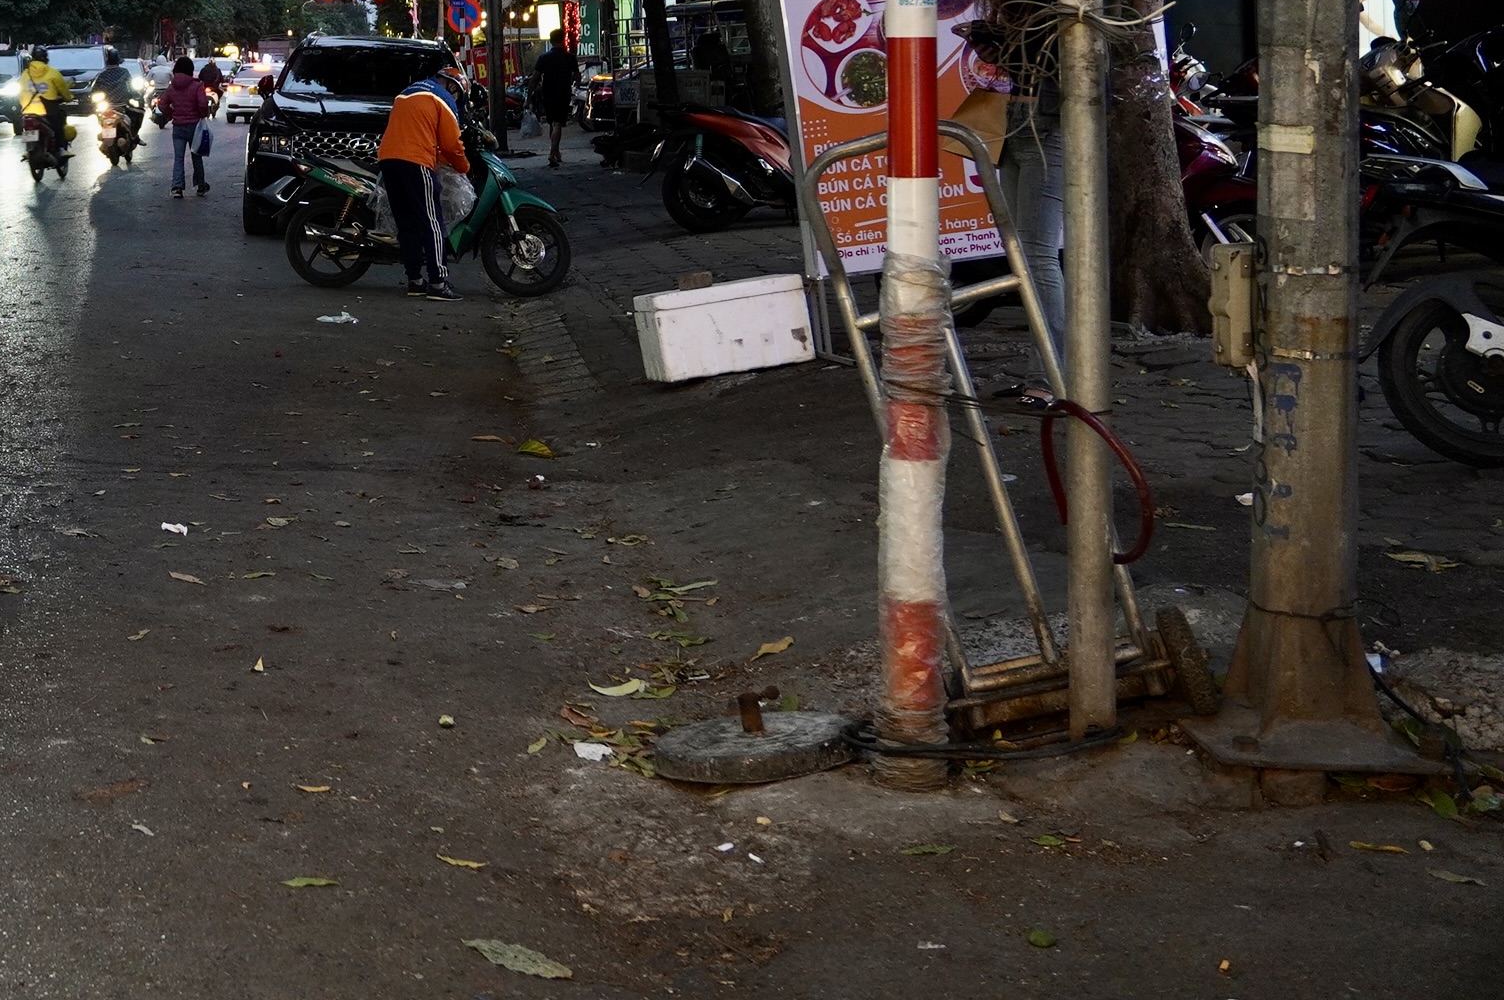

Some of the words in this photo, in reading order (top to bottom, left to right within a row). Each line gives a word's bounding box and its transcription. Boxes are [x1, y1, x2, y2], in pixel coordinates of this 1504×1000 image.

[851, 154, 871, 171] CÁ
[818, 177, 849, 195] BÚN
[853, 173, 874, 190] CÁ
[820, 195, 851, 213] BÚN
[854, 192, 876, 209] CÁ
[946, 217, 978, 230] hàng
[837, 229, 851, 243] Số
[855, 229, 883, 242] điện
[965, 231, 995, 242] Thanh
[945, 246, 968, 255] Được
[970, 243, 991, 252] Phục
